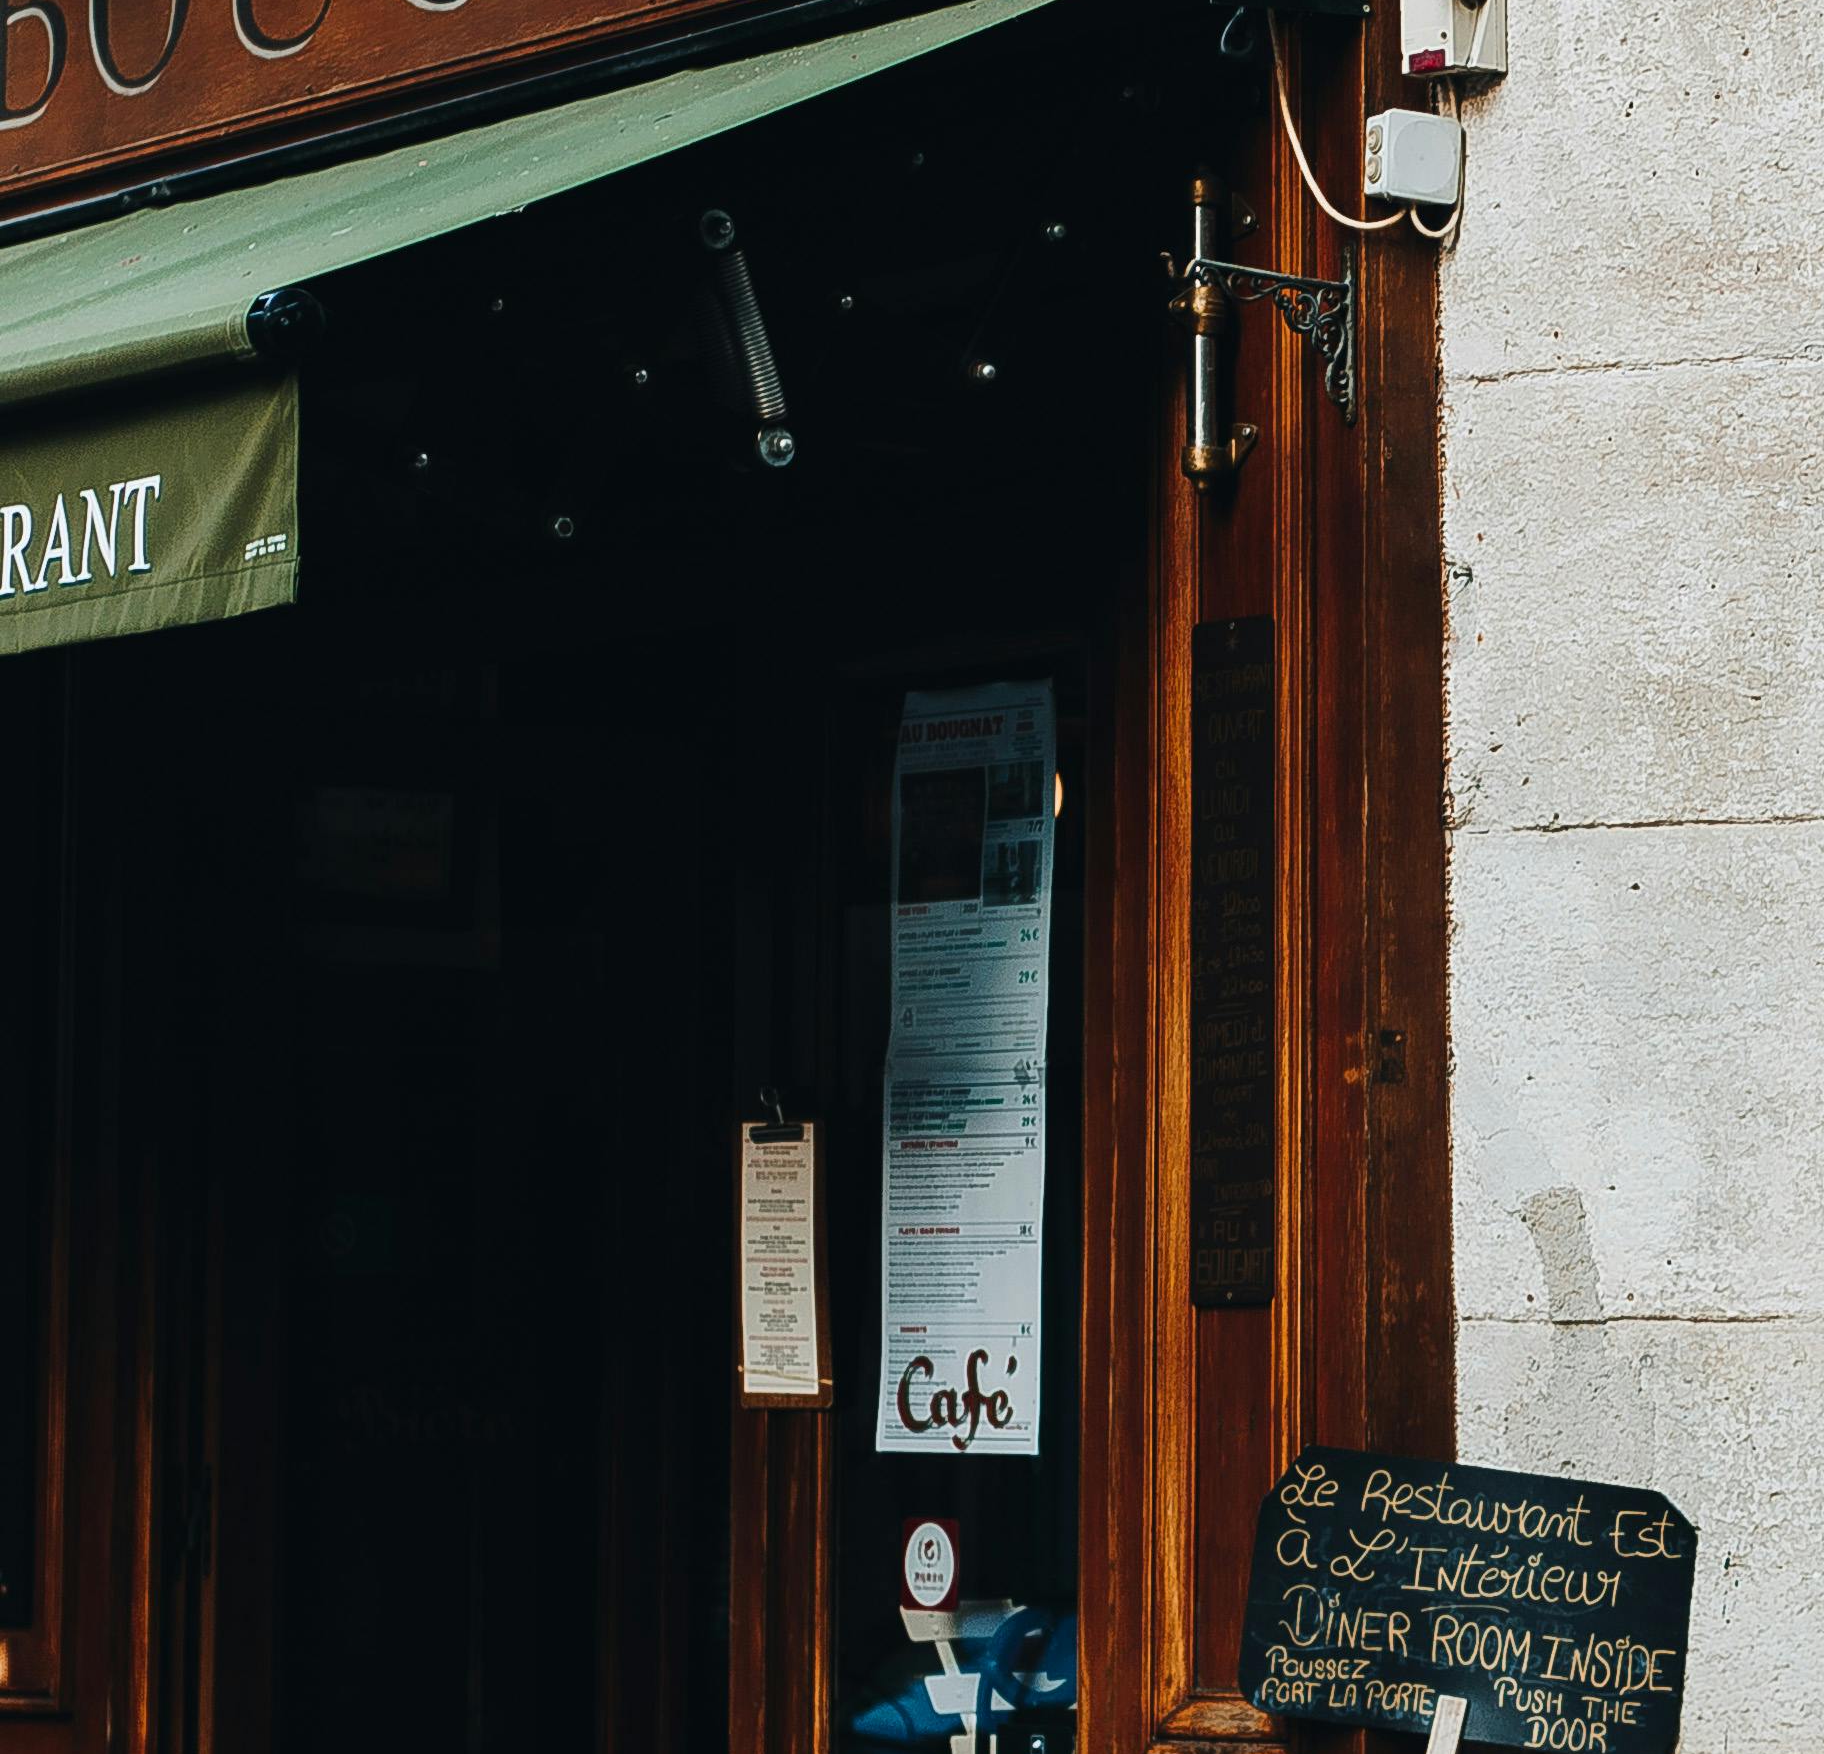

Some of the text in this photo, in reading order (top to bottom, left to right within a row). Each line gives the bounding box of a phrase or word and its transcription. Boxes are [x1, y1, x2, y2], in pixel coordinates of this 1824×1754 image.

[0, 474, 162, 596] RANT
[897, 1348, 1018, 1451] Café
[1280, 1463, 1682, 1559] Le Restaurant Est
[1432, 1613, 1531, 1675] ROOM
[1328, 1682, 1358, 1708] LA
[1364, 1679, 1436, 1716] PORTE
[1494, 1677, 1643, 1725] PUSH THE
[1524, 1715, 1607, 1754] DOOR
